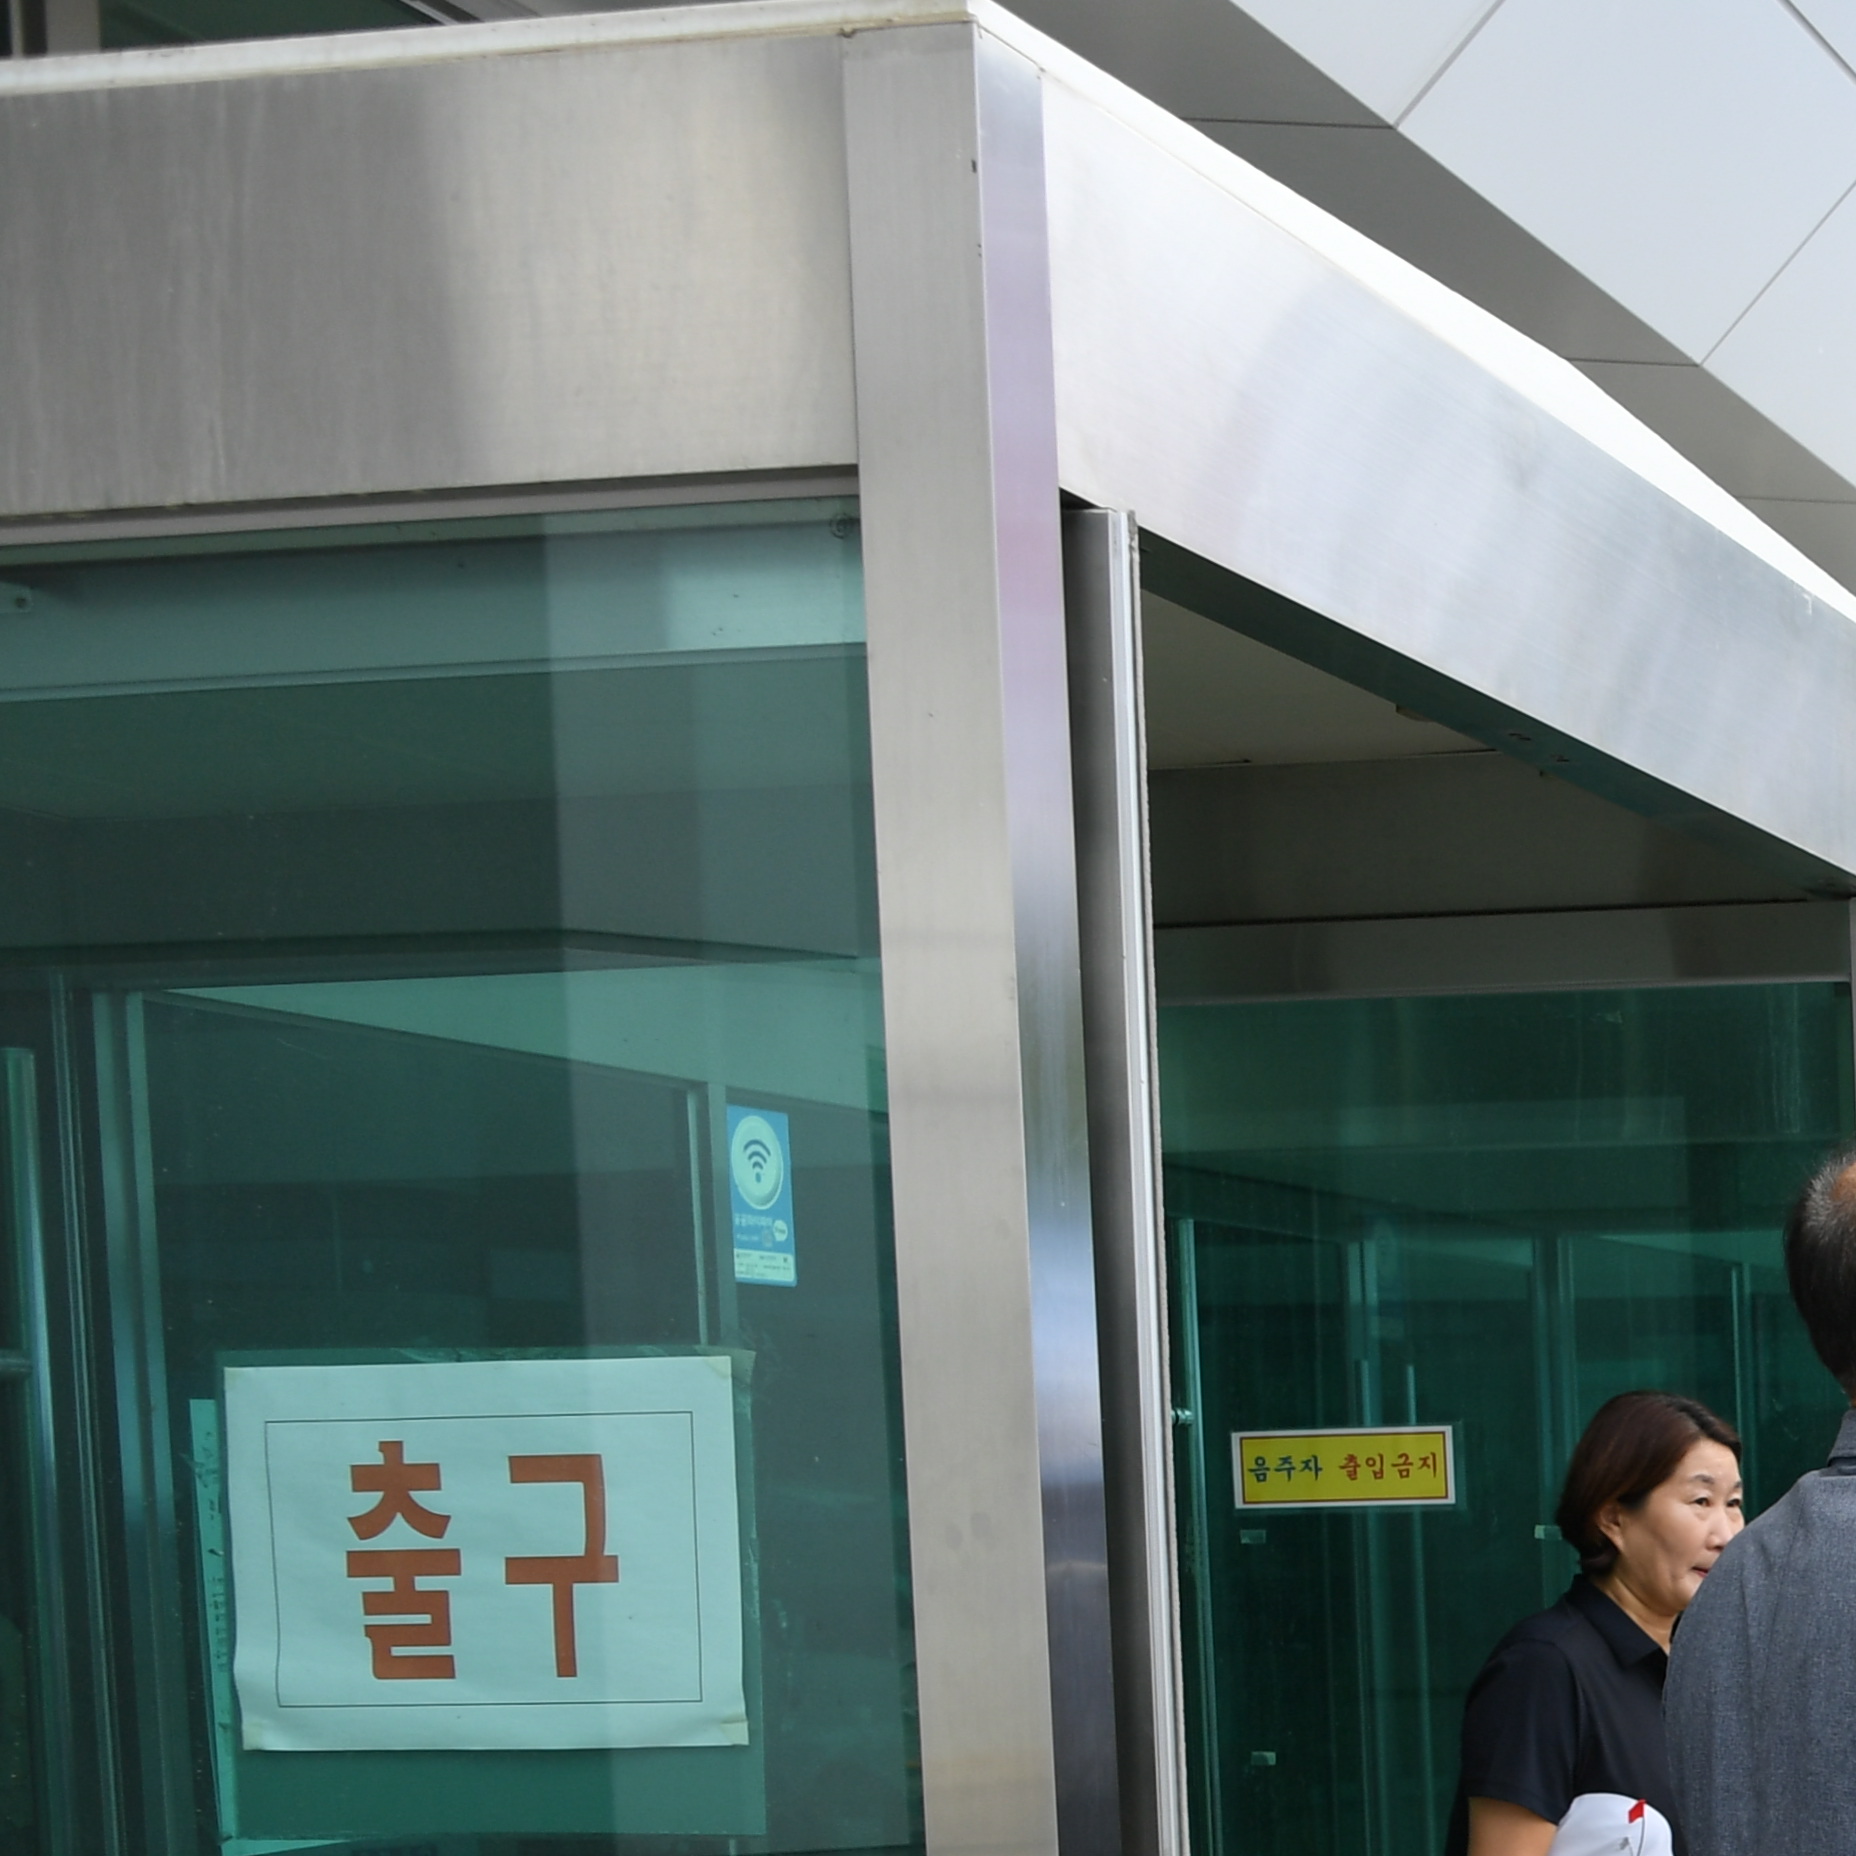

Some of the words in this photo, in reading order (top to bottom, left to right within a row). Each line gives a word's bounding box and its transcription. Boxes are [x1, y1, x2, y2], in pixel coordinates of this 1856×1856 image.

[1248, 1454, 1323, 1484] 음주자
[1338, 1451, 1439, 1482] 출입금지
[345, 1440, 620, 1681] 출구
